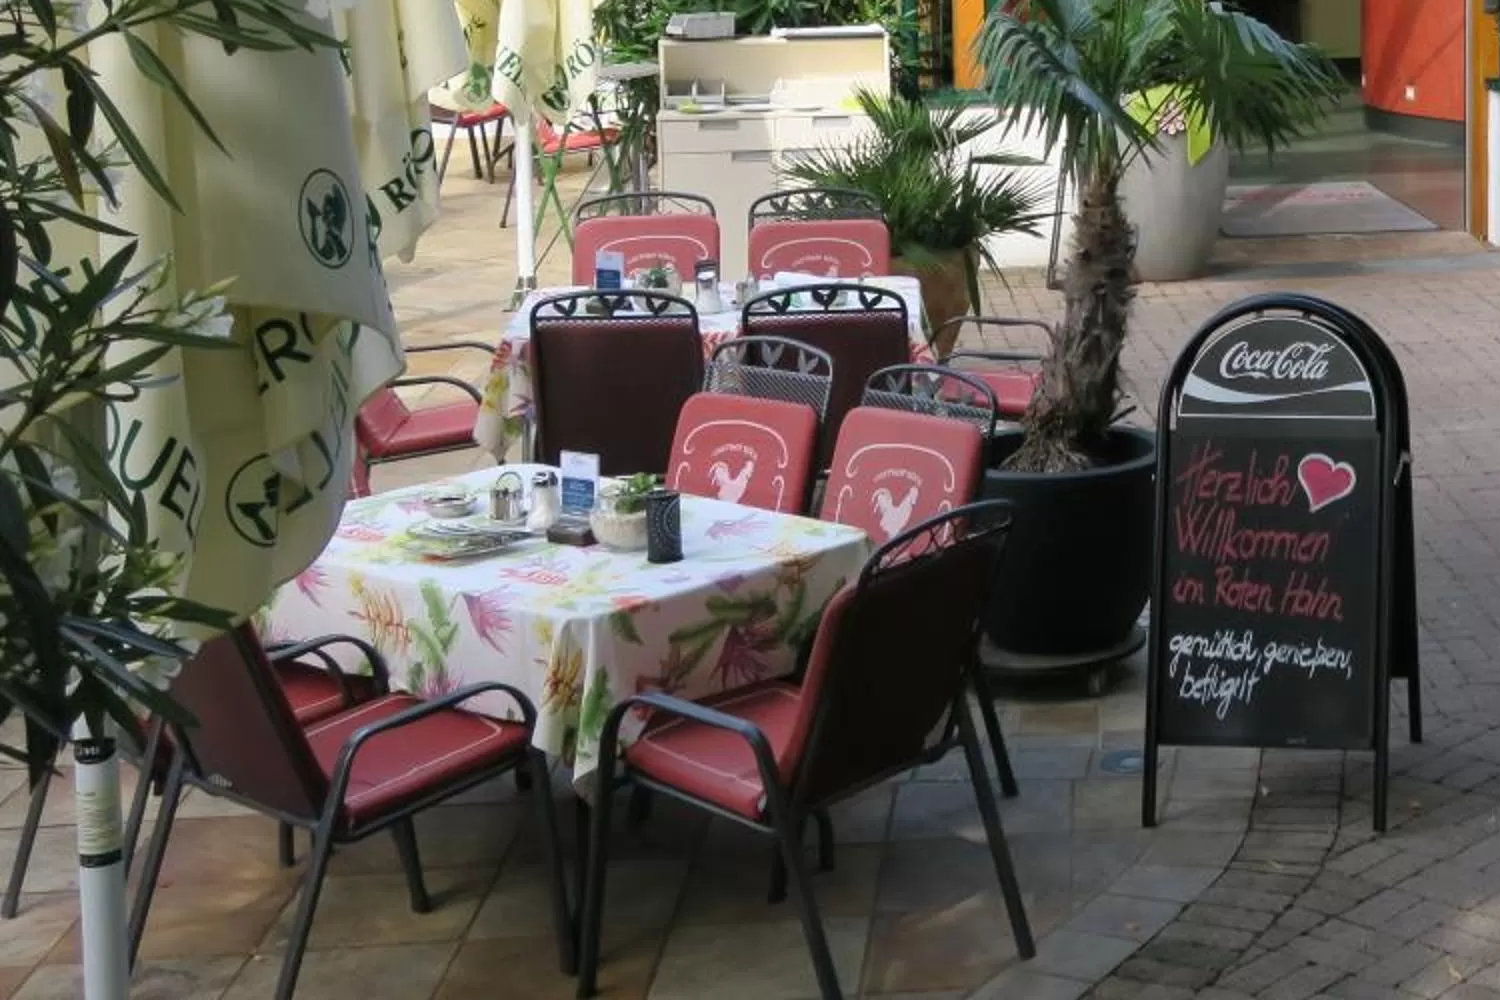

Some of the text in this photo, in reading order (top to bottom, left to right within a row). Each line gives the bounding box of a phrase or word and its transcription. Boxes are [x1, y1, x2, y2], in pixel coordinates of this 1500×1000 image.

[1219, 341, 1337, 379] Coca-Cola
[1176, 440, 1298, 505] Herzlich
[1175, 502, 1330, 563] Willkommen
[1214, 565, 1275, 614] Roten
[1280, 568, 1345, 622] Hahn
